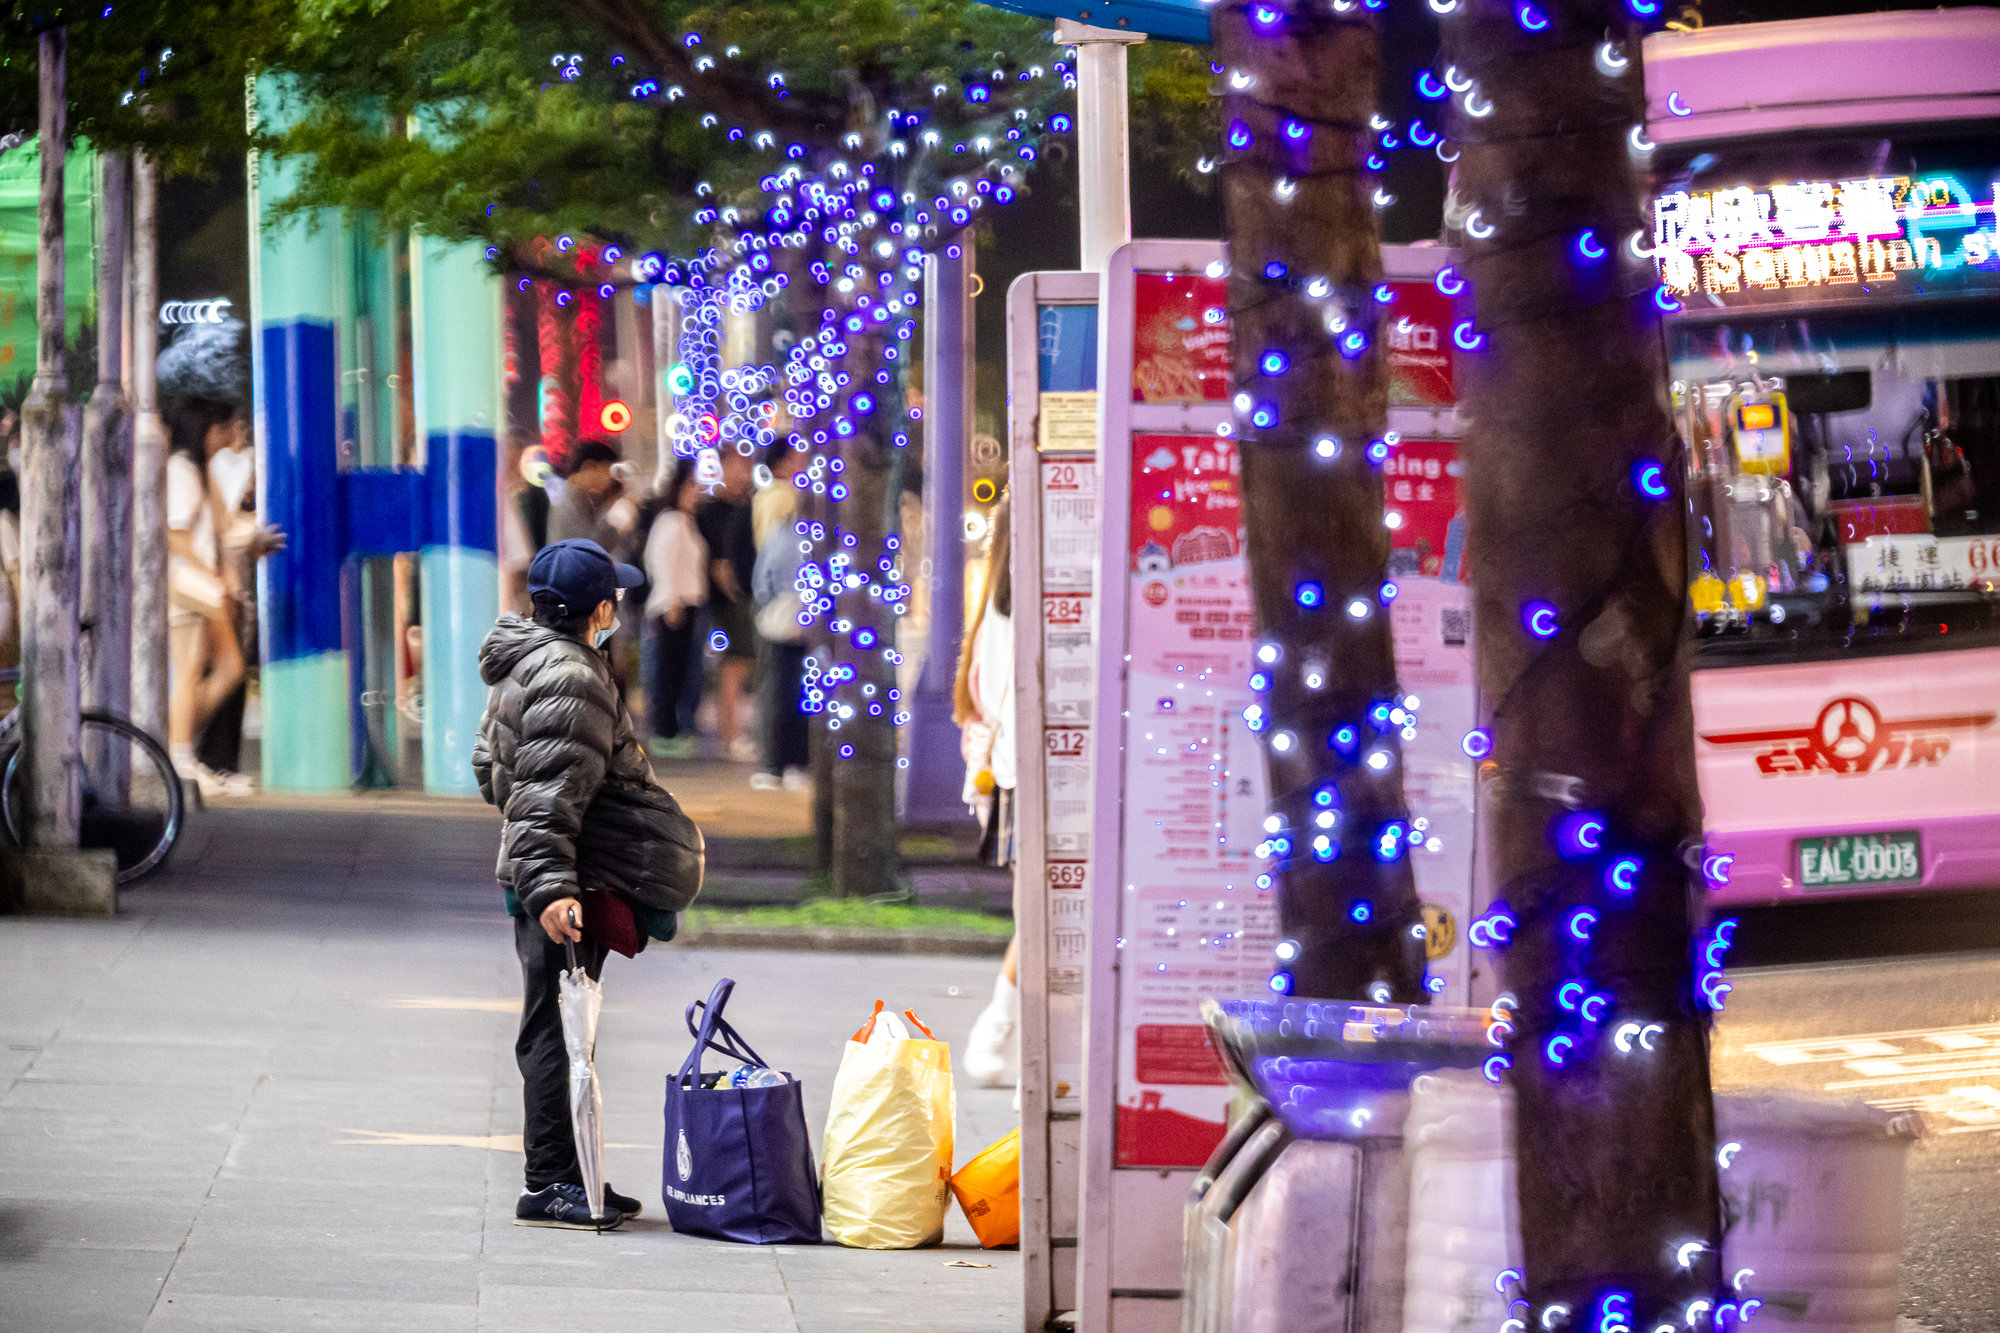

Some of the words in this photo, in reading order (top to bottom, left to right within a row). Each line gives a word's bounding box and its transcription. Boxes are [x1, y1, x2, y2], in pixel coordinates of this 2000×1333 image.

[1050, 466, 1075, 483] 20
[1383, 453, 1441, 479] eing
[1045, 600, 1083, 618] 284
[1047, 732, 1084, 749] 612
[1048, 865, 1085, 883] 669
[673, 1188, 726, 1206] APPLIANCES
